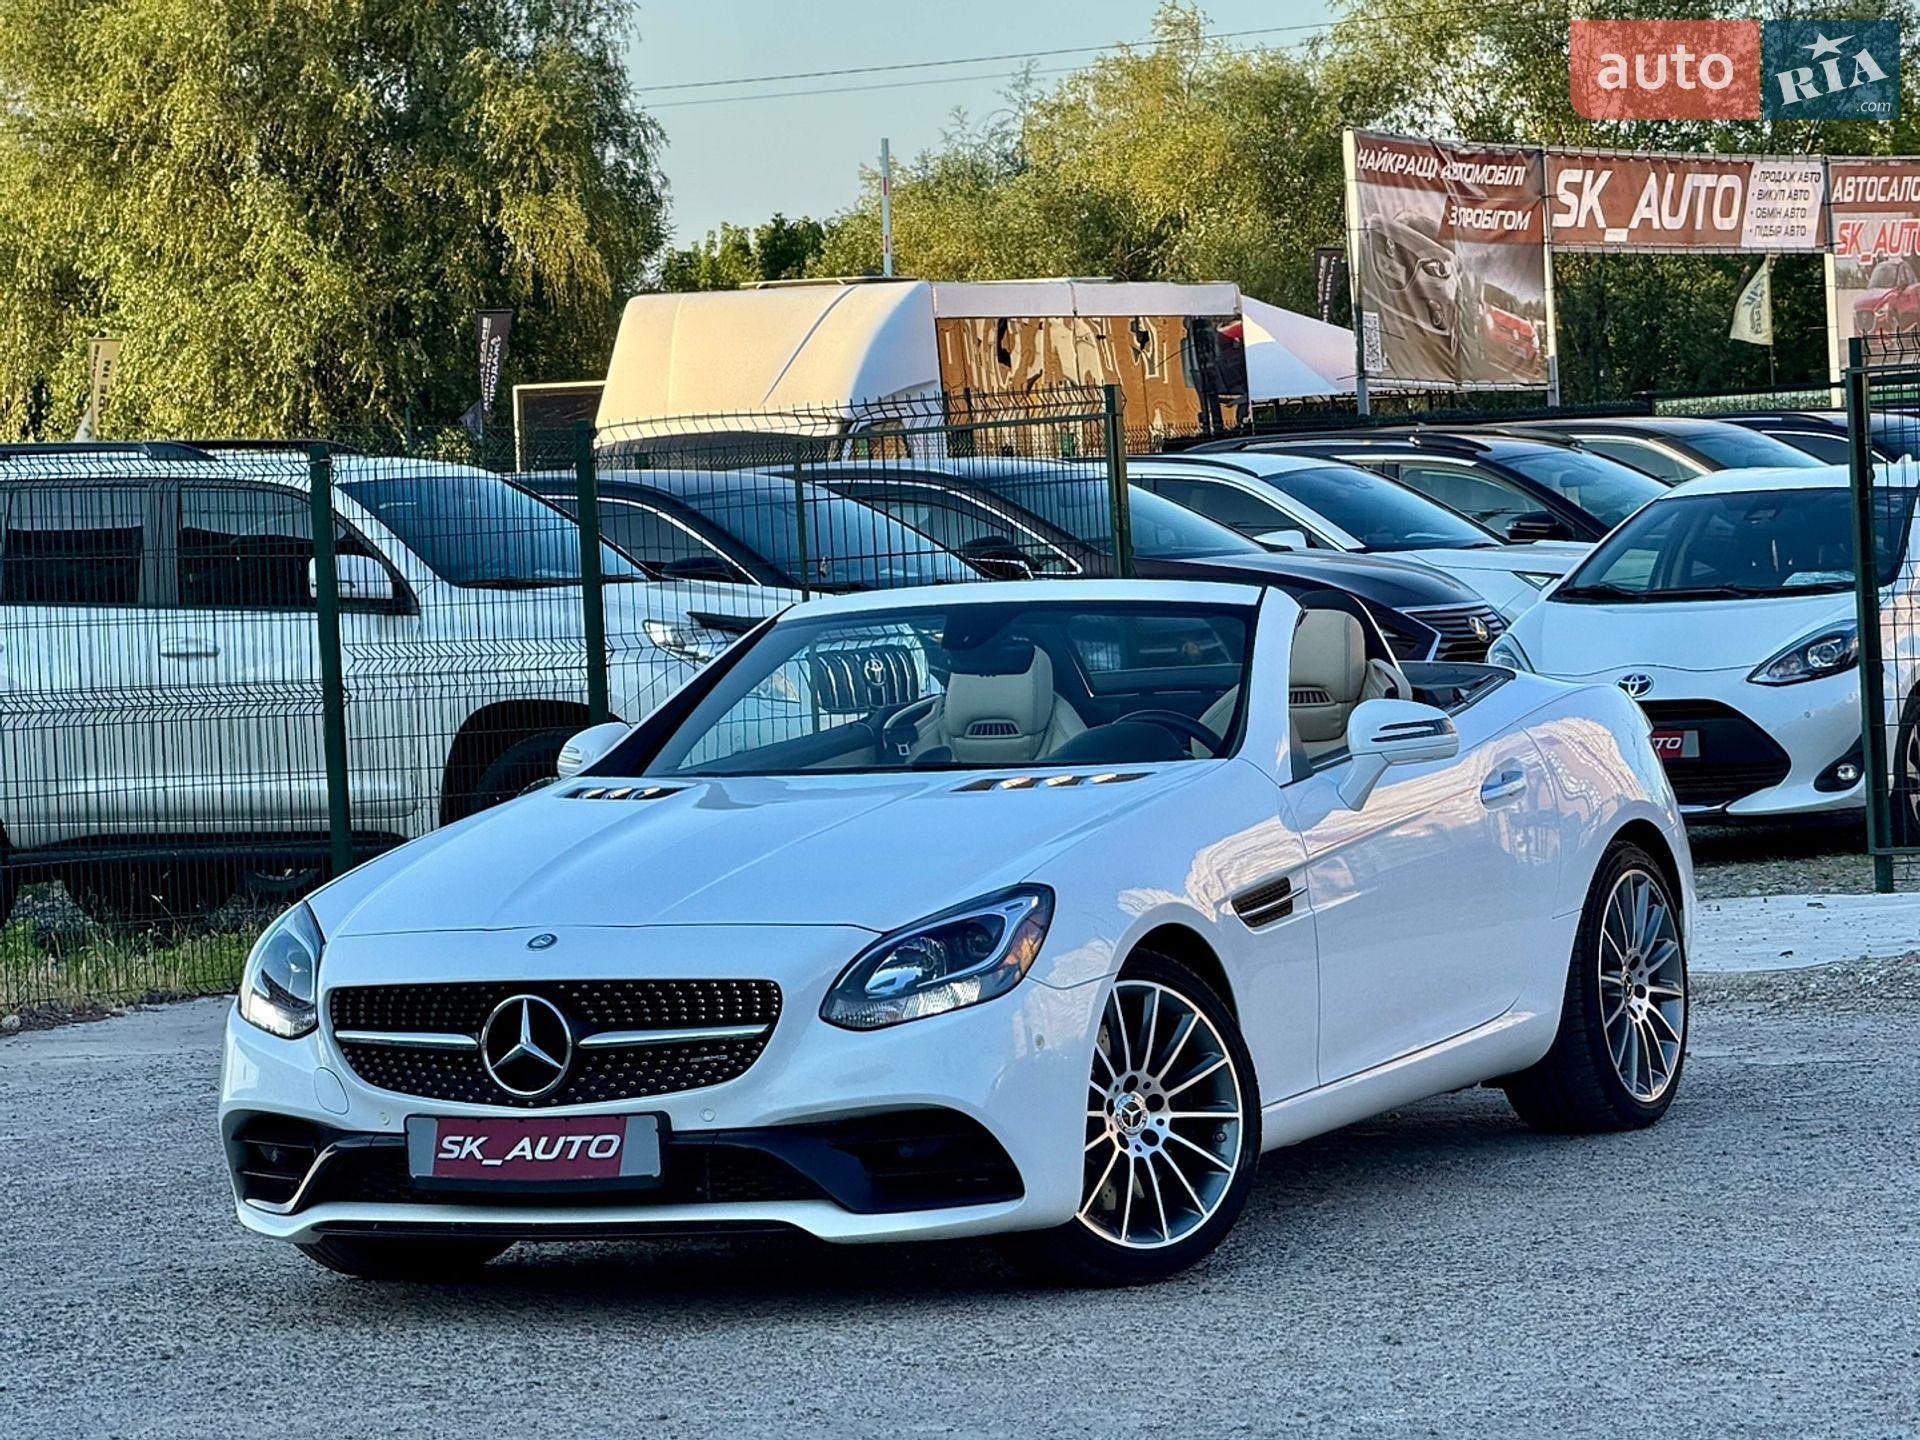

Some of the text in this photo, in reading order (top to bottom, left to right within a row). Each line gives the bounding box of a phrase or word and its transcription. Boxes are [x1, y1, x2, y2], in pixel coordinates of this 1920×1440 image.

[1357, 147, 1527, 187] НАЙКРАЩІ АВТОМОБІЛІ
[1759, 170, 1821, 183] ПРОДАЖ АВТО
[1757, 189, 1810, 201] ВИКУП АВТО
[1552, 168, 1743, 242] SK_AUTO
[1755, 207, 1807, 219] ОБМІН АВТО
[1457, 207, 1532, 231] ПРОБІГОМ
[1755, 225, 1807, 238] ПІДБІР АВТО
[437, 1134, 622, 1166] SK_AUTO
